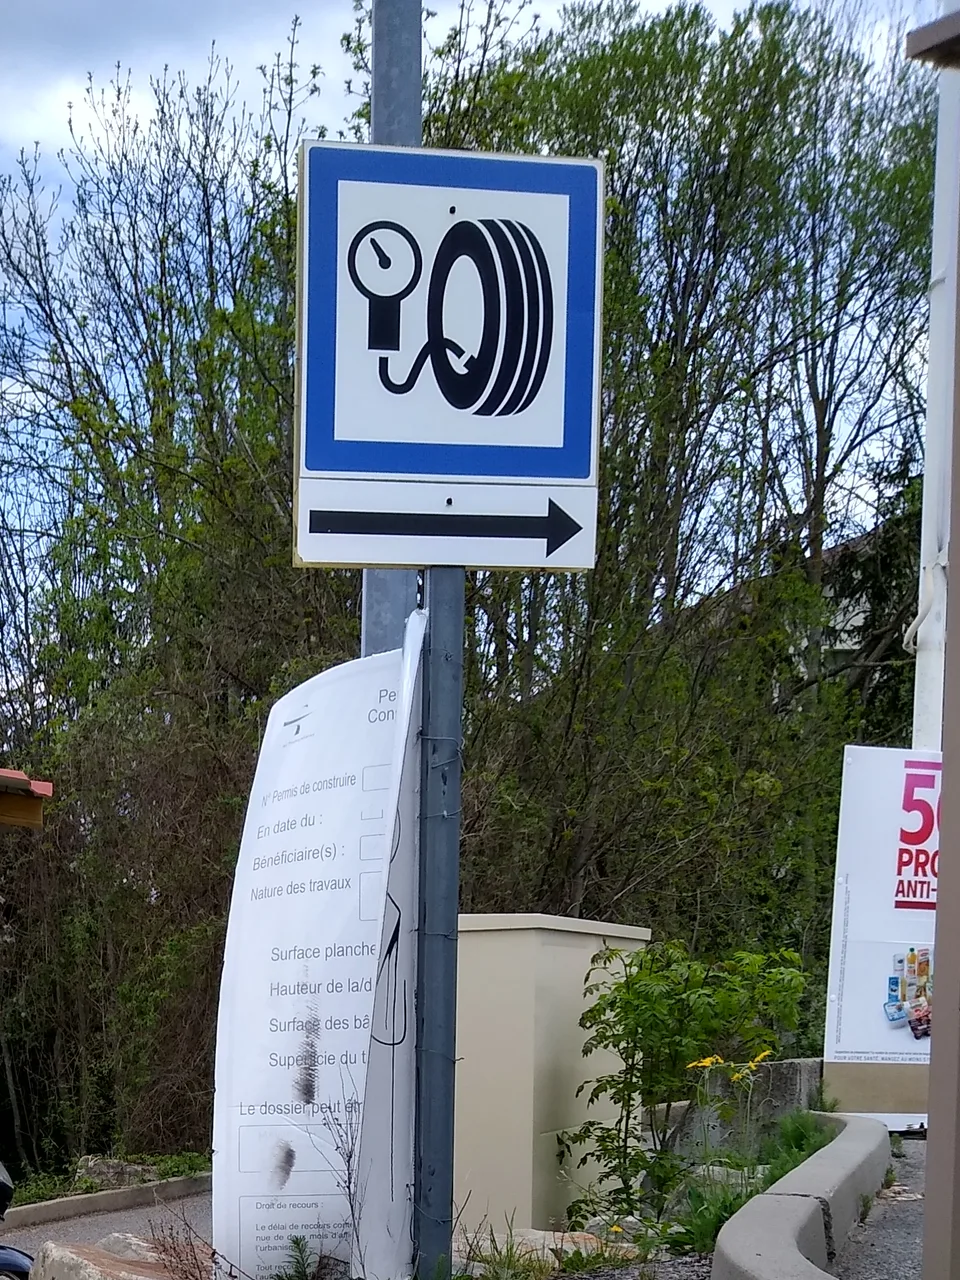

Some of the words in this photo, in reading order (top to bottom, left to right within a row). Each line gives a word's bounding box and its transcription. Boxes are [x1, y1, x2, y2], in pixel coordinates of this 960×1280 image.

[378, 688, 398, 704] Pe
[367, 708, 398, 724] Con
[272, 784, 298, 804] Permis
[300, 782, 311, 795] de
[312, 772, 357, 793] construire
[898, 773, 941, 846] 5
[257, 825, 271, 840] En
[273, 818, 297, 834] date
[300, 813, 316, 828] du
[252, 843, 337, 871] Bénéficiaire(s)
[250, 885, 284, 901] Nature
[286, 881, 306, 896] des
[309, 877, 352, 893] travaux
[270, 945, 321, 962] Surface
[270, 980, 323, 997] Hauteur
[326, 978, 343, 994] de
[347, 977, 372, 993] la/d
[269, 1016, 321, 1033] Surface
[325, 1015, 350, 1030] des
[353, 1014, 370, 1030] bâ
[340, 1050, 357, 1065] du
[239, 1101, 256, 1116] Le
[259, 1101, 307, 1115] dossier
[311, 1100, 341, 1118] peut
[255, 1201, 275, 1210] Droit
[276, 1201, 287, 1210] de
[289, 1201, 319, 1209] recours
[255, 1223, 266, 1232] Le
[268, 1222, 287, 1232] délai
[289, 1222, 299, 1231] de
[301, 1222, 331, 1231] recours
[255, 1234, 271, 1242] nue
[274, 1233, 284, 1242] de
[309, 1231, 328, 1240] mois
[256, 1264, 273, 1272] Tout
